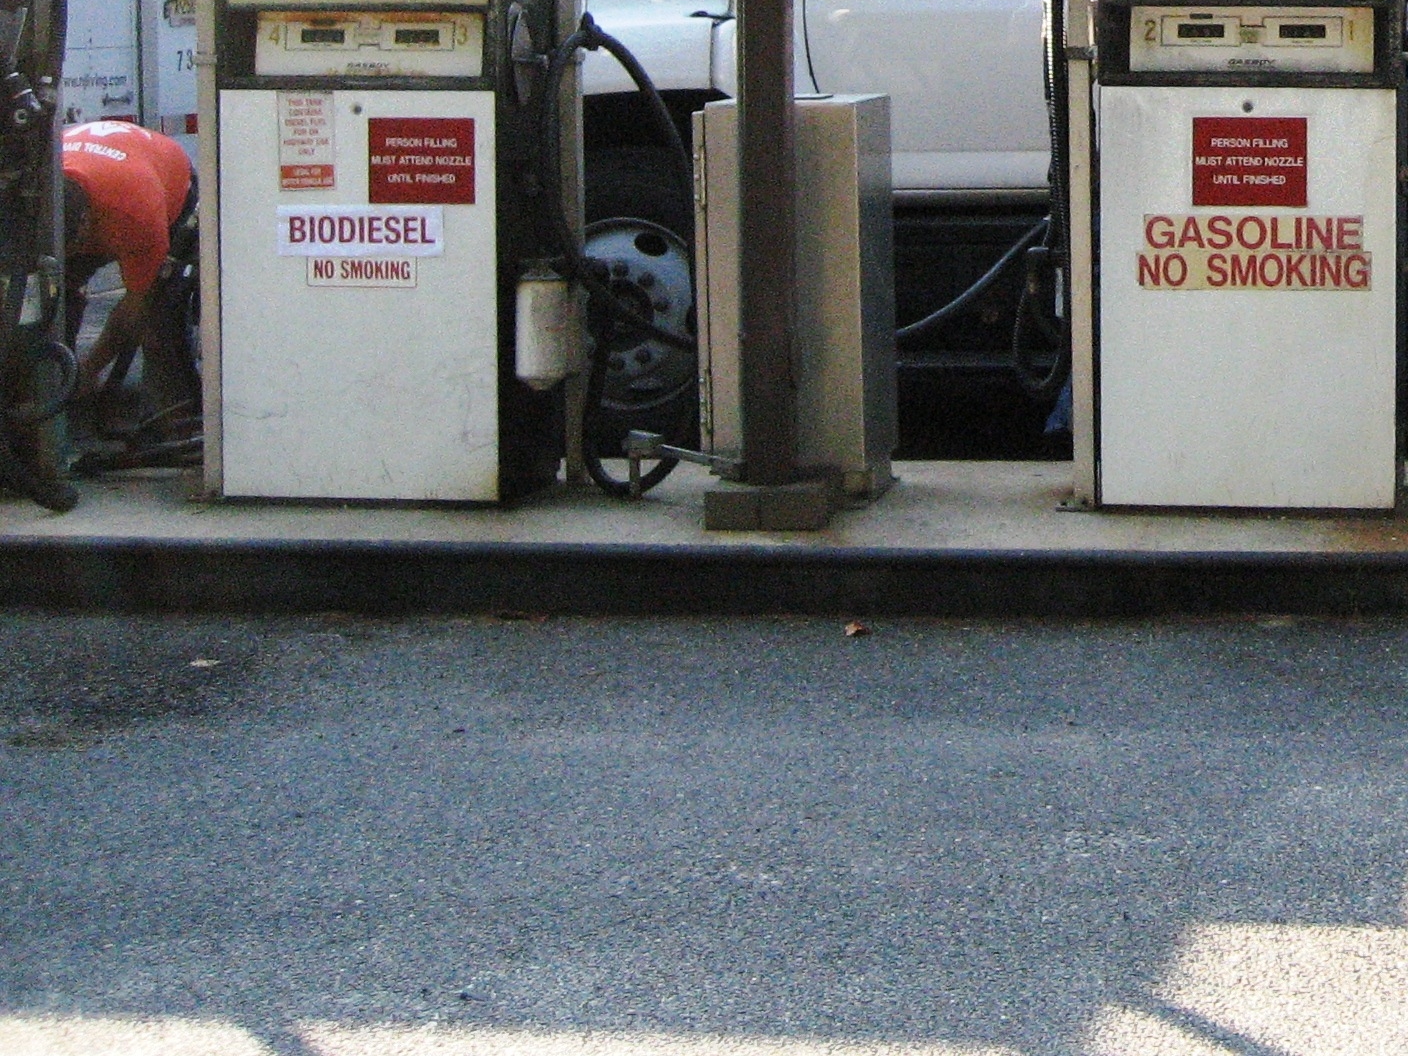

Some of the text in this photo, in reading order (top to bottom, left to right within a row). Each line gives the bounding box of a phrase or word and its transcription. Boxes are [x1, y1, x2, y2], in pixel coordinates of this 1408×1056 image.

[268, 25, 280, 45] 4
[457, 24, 468, 46] 3
[1144, 19, 1157, 43] 2
[385, 137, 457, 149] PERSON FILLING
[1211, 137, 1288, 149] PERSON FILLING
[371, 155, 471, 166] MUST ATTEND NOZZLE
[1195, 155, 1304, 167] MUST ATTEND NOZZLE
[388, 173, 456, 185] UNTIL FINISHED
[1213, 174, 1287, 186] UNTIL FINISHED
[289, 216, 436, 244] BIODIESEL
[1144, 215, 1362, 250] GASOLINE
[313, 259, 411, 281] NO SMOKING
[1137, 253, 1370, 288] NO SMOKING
